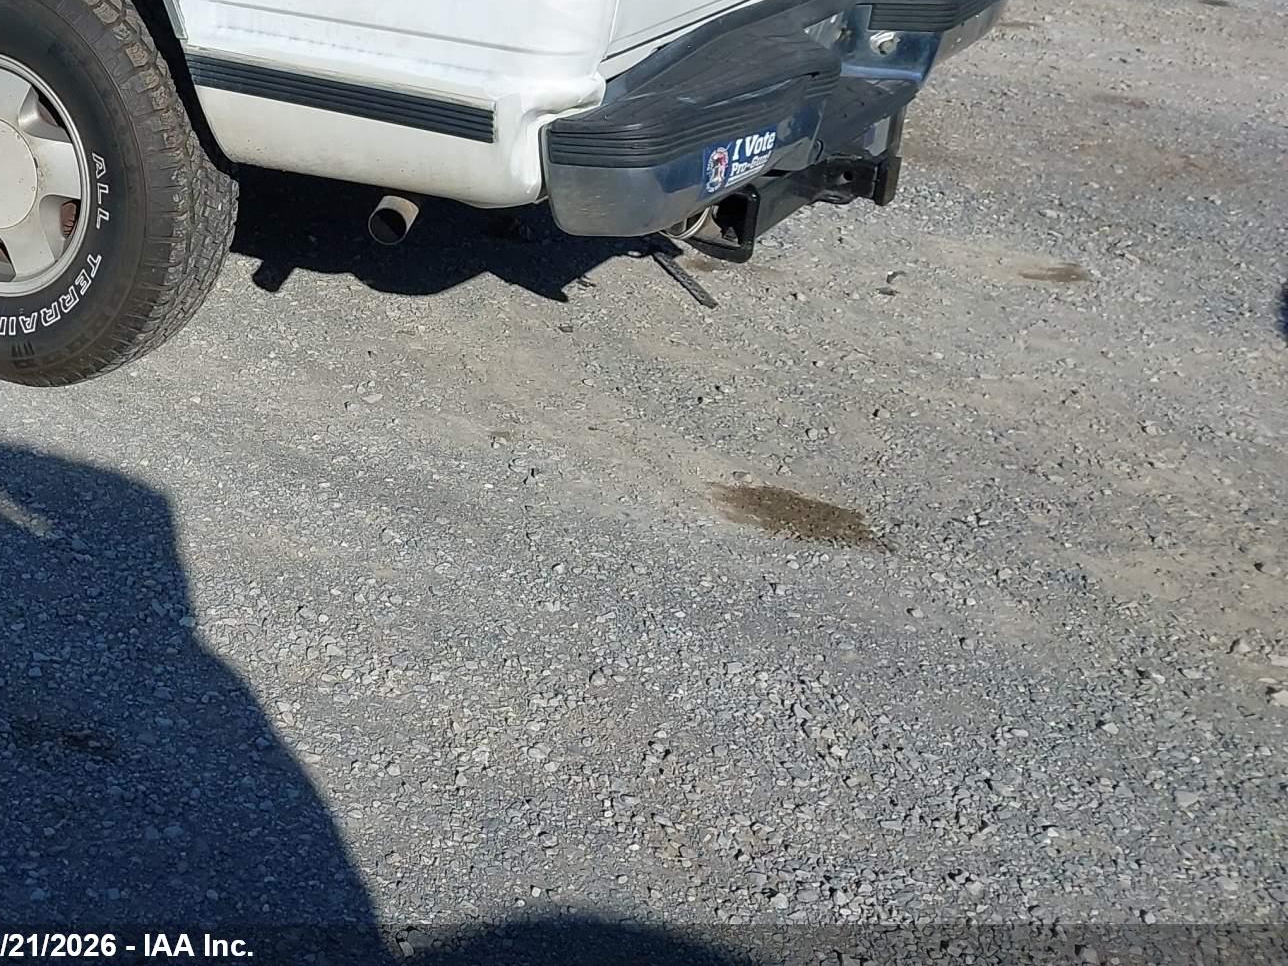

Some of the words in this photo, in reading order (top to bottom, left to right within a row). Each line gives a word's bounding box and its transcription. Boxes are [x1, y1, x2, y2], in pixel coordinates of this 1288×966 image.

[732, 138, 744, 161] I
[744, 131, 776, 157] Vote
[92, 152, 110, 229] ALL
